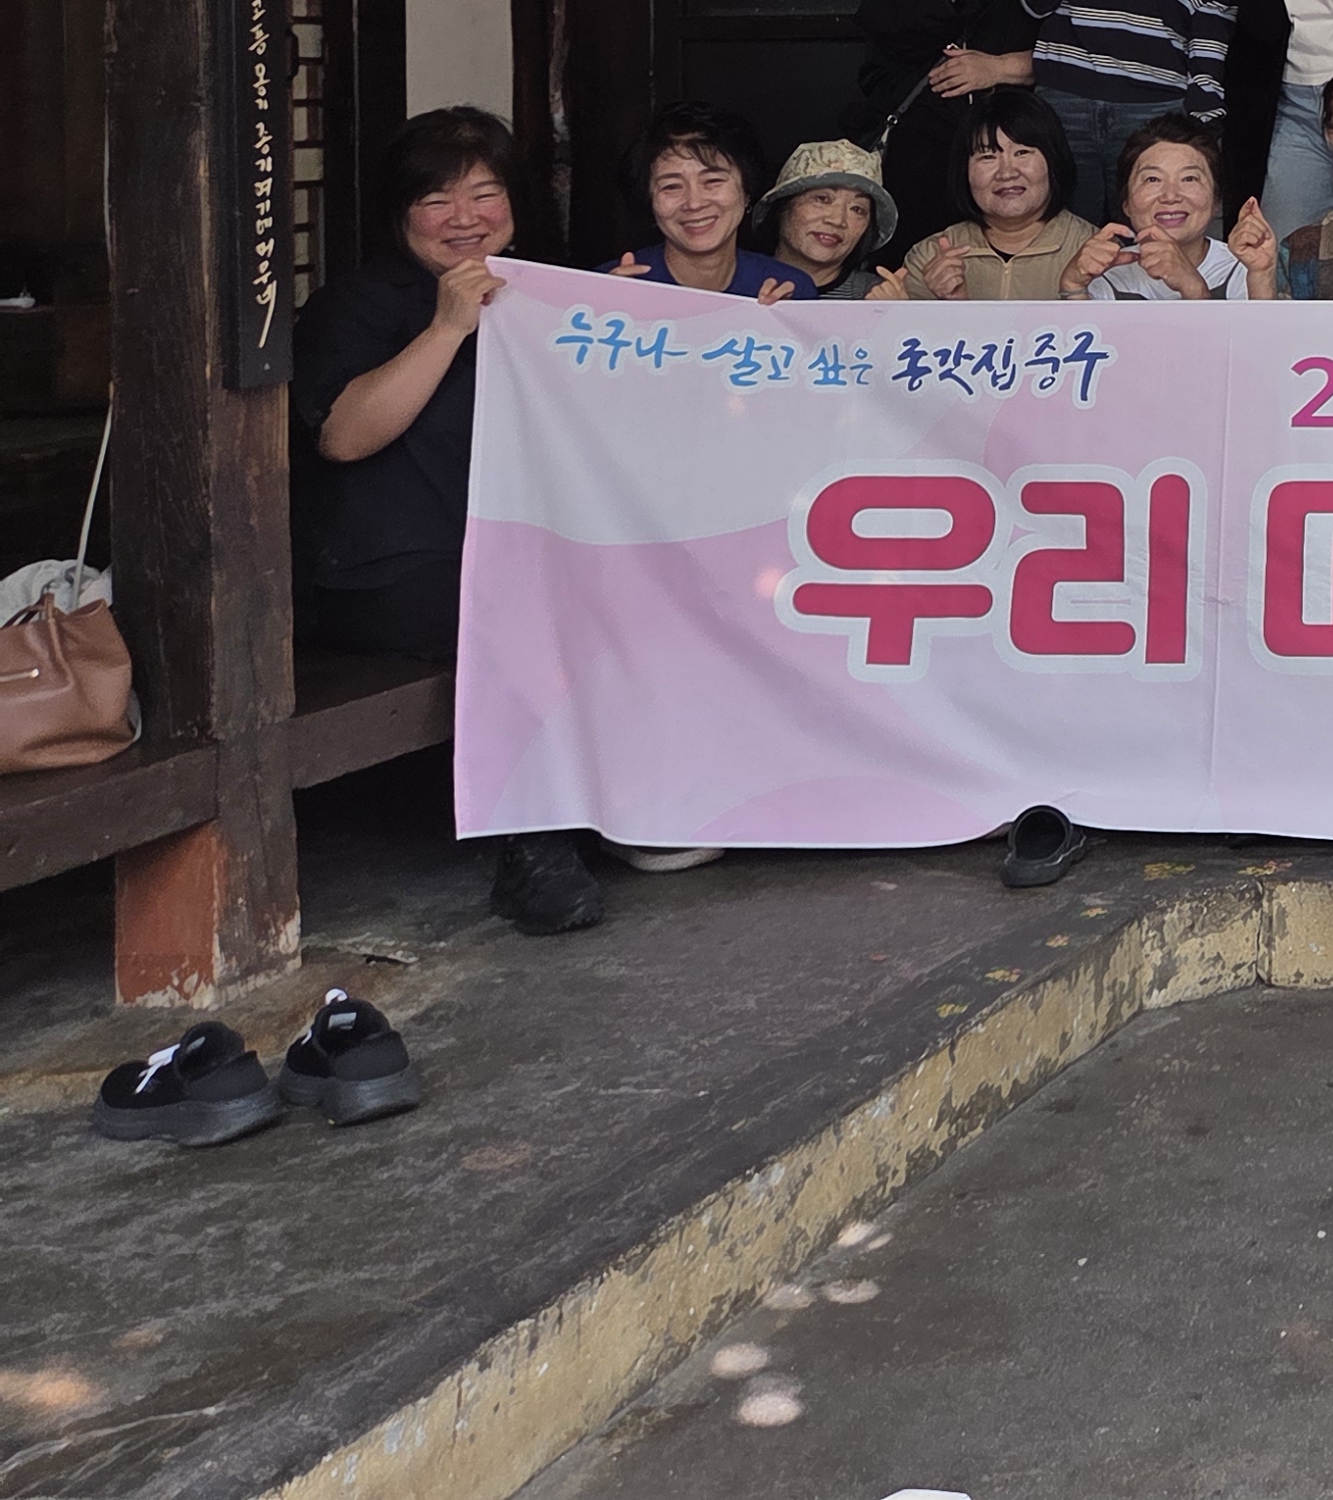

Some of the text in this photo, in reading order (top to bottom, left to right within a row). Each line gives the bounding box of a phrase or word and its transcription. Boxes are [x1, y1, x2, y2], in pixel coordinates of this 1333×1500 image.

[555, 312, 686, 370] 누구나
[702, 336, 795, 387] 살고
[808, 344, 873, 386] 싶은
[793, 474, 1190, 665] 우리
